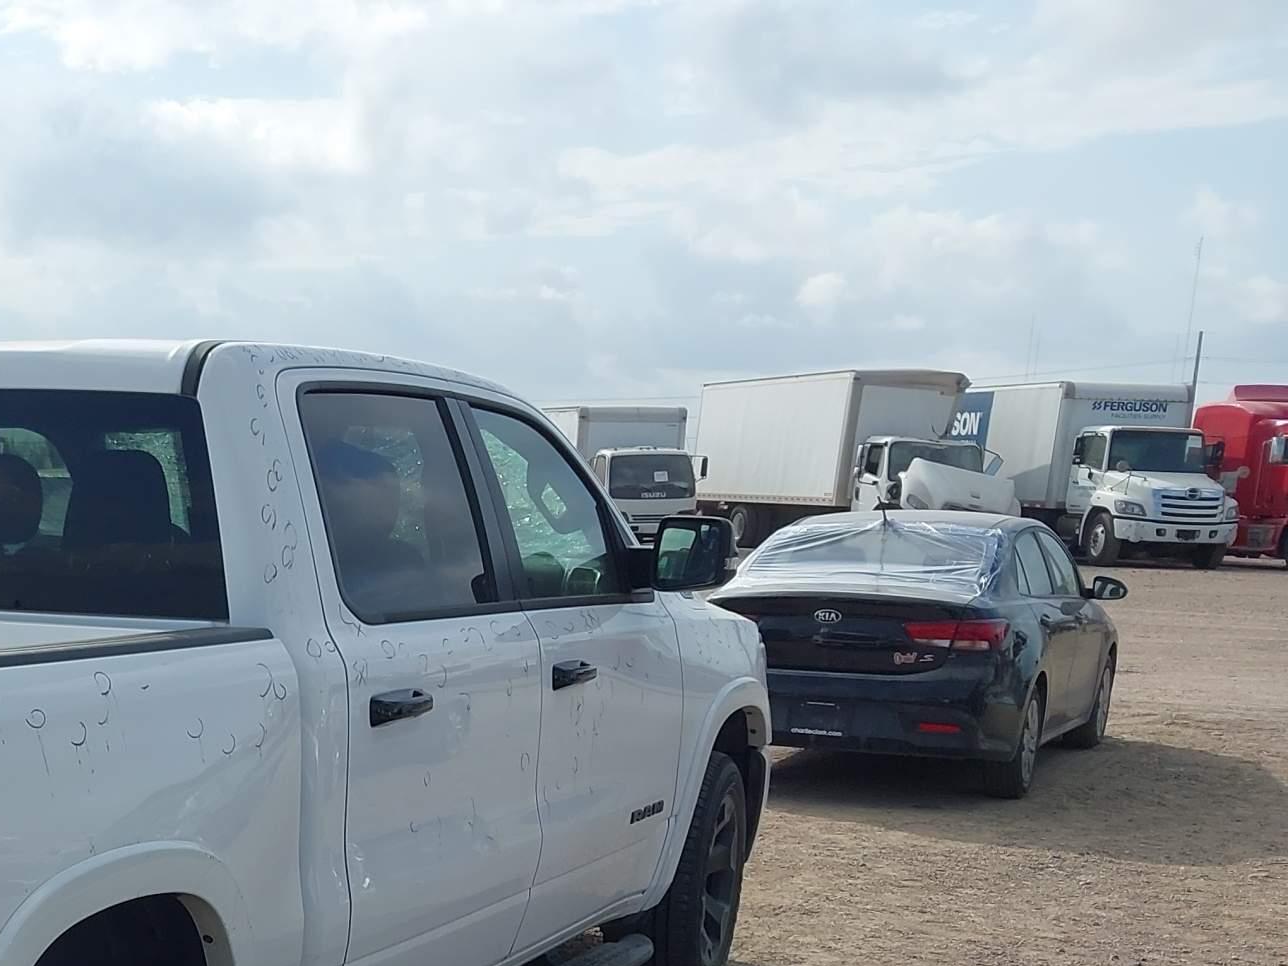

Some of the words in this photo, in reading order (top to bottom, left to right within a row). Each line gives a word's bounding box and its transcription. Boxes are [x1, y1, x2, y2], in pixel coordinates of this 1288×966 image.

[1103, 401, 1168, 413] FERGUSON
[951, 412, 980, 436] SON
[630, 799, 665, 825] RAM
